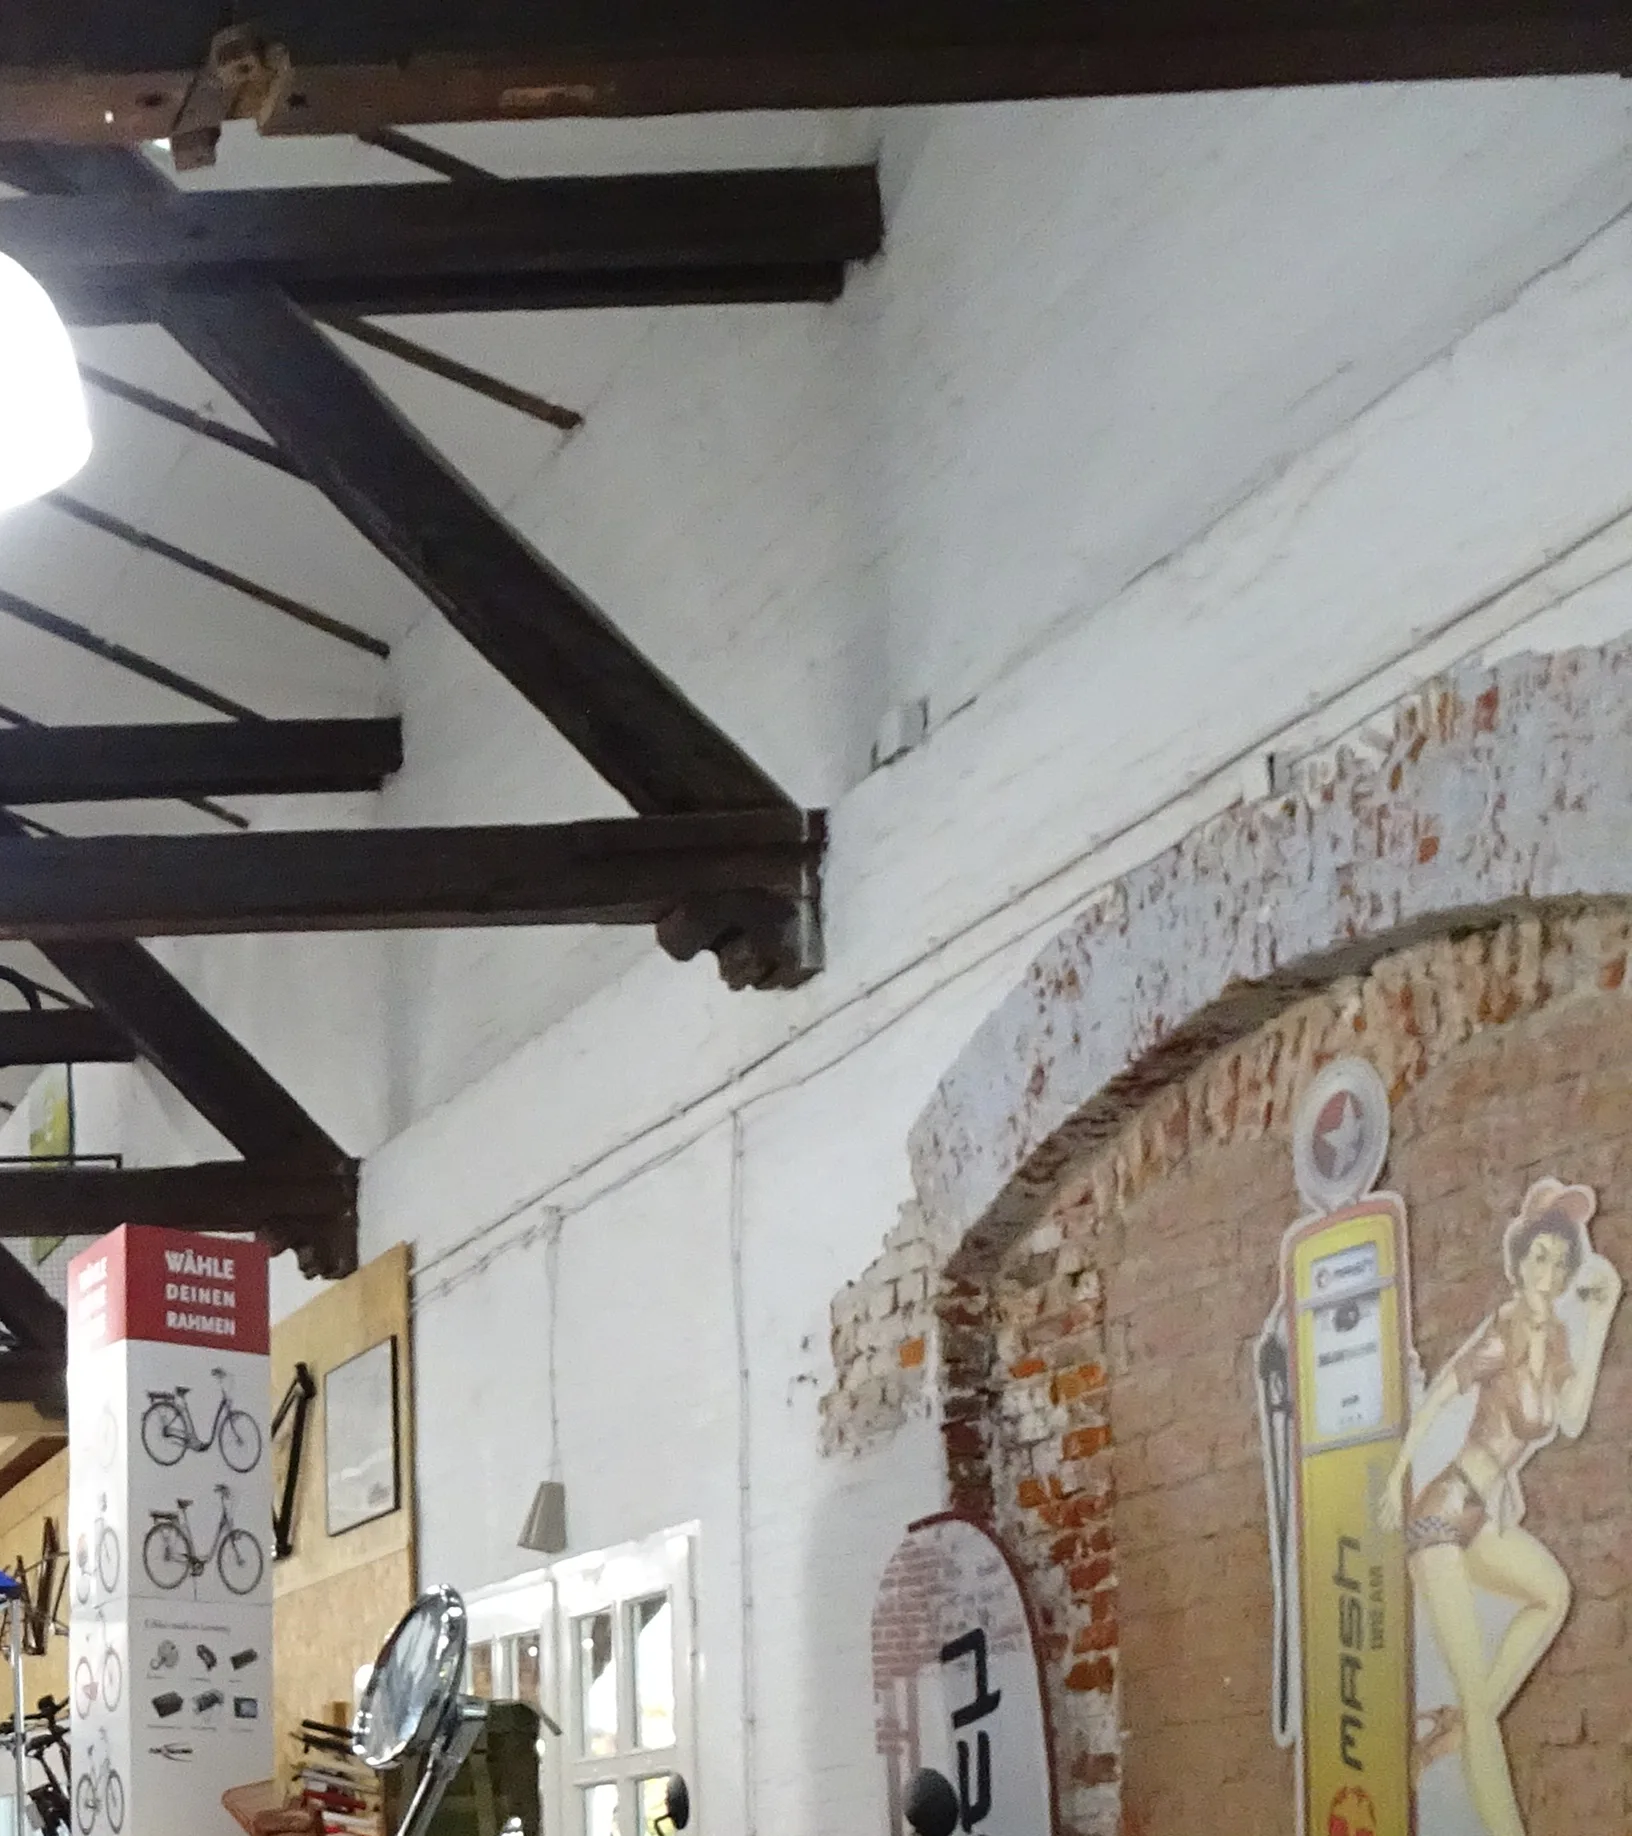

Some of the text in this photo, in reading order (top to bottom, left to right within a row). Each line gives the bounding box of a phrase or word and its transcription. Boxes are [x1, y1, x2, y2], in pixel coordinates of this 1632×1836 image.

[165, 1249, 234, 1279] WÄHLE
[165, 1283, 235, 1308] DEINEN
[165, 1310, 235, 1335] RAHMEN
